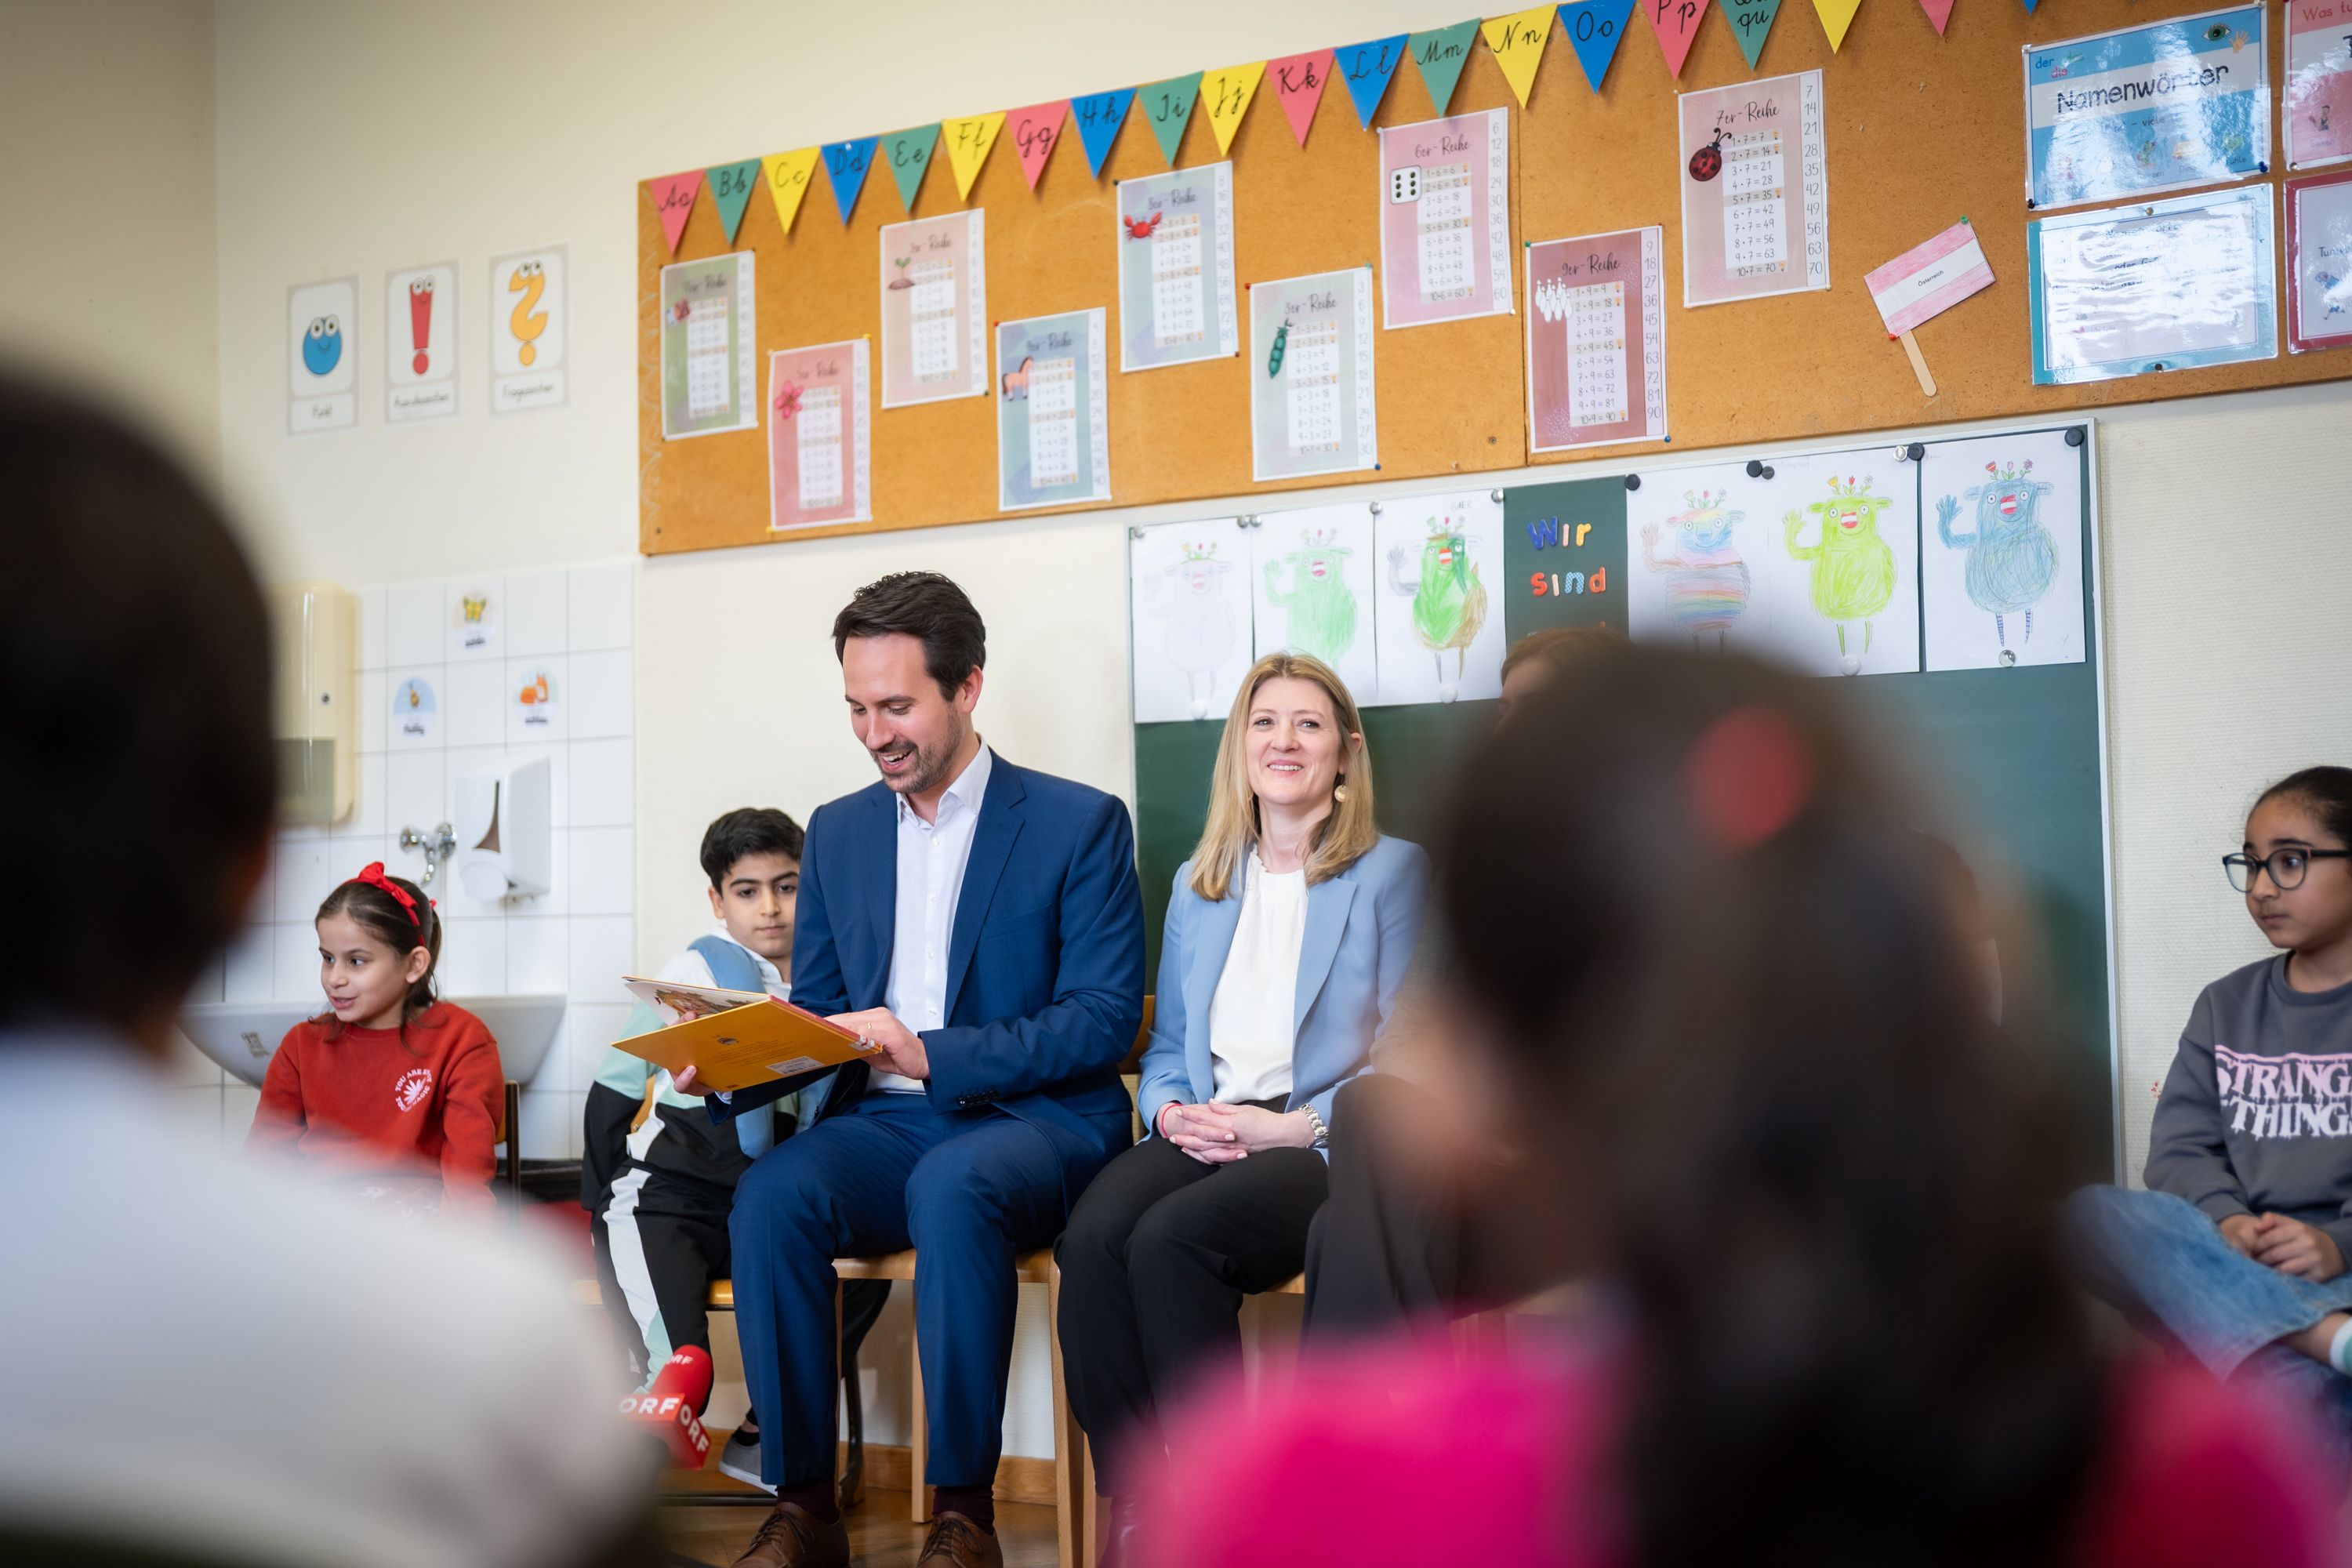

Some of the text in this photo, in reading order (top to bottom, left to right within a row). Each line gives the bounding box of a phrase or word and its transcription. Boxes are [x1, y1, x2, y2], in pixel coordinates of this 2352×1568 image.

[2303, 6, 2332, 21] Was
[2035, 56, 2055, 68] der
[2051, 66, 2068, 78] die
[1806, 85, 1813, 98] 7
[1716, 99, 1780, 125] 7er-Reihe
[1805, 102, 1816, 115] 14
[1493, 122, 1499, 134] 6
[1804, 122, 1817, 135] 21
[1415, 133, 1469, 158] 6er-Reihe
[1491, 138, 1502, 150] 12
[1805, 143, 1817, 157] 28
[1490, 156, 1501, 168] 18
[1806, 163, 1818, 176] 35
[1490, 176, 1501, 188] 24
[1806, 183, 1819, 195] 42
[1488, 193, 1503, 209] 30
[1807, 202, 1820, 215] 49
[1490, 212, 1502, 225] 36
[1808, 222, 1820, 235] 56
[1491, 231, 1503, 243] 42
[1646, 241, 1653, 252] 9
[1808, 240, 1824, 255] 63
[1492, 249, 1504, 262] 48
[1562, 252, 1620, 276] 9er-Reihe
[1644, 257, 1656, 270] 18
[1810, 262, 1822, 274] 70
[1494, 269, 1505, 281] 54
[1645, 275, 1656, 288] 27
[1918, 270, 1944, 286] Österreich
[1493, 285, 1508, 301] 60
[1645, 293, 1659, 307] 36
[1645, 313, 1657, 325] 45
[1646, 332, 1657, 345] 54
[1646, 350, 1661, 364] 63
[1647, 371, 1659, 384] 72
[1648, 387, 1661, 401] 81
[1647, 407, 1661, 419] 90
[1526, 516, 1592, 550] Wir
[1530, 567, 1606, 597] sind
[395, 1076, 406, 1091] YOU
[407, 1069, 422, 1079] ARE
[2216, 1056, 2352, 1104] STRANG
[2230, 1095, 2352, 1141] THING
[618, 1397, 680, 1414] ORF
[680, 1404, 710, 1452] ORF
